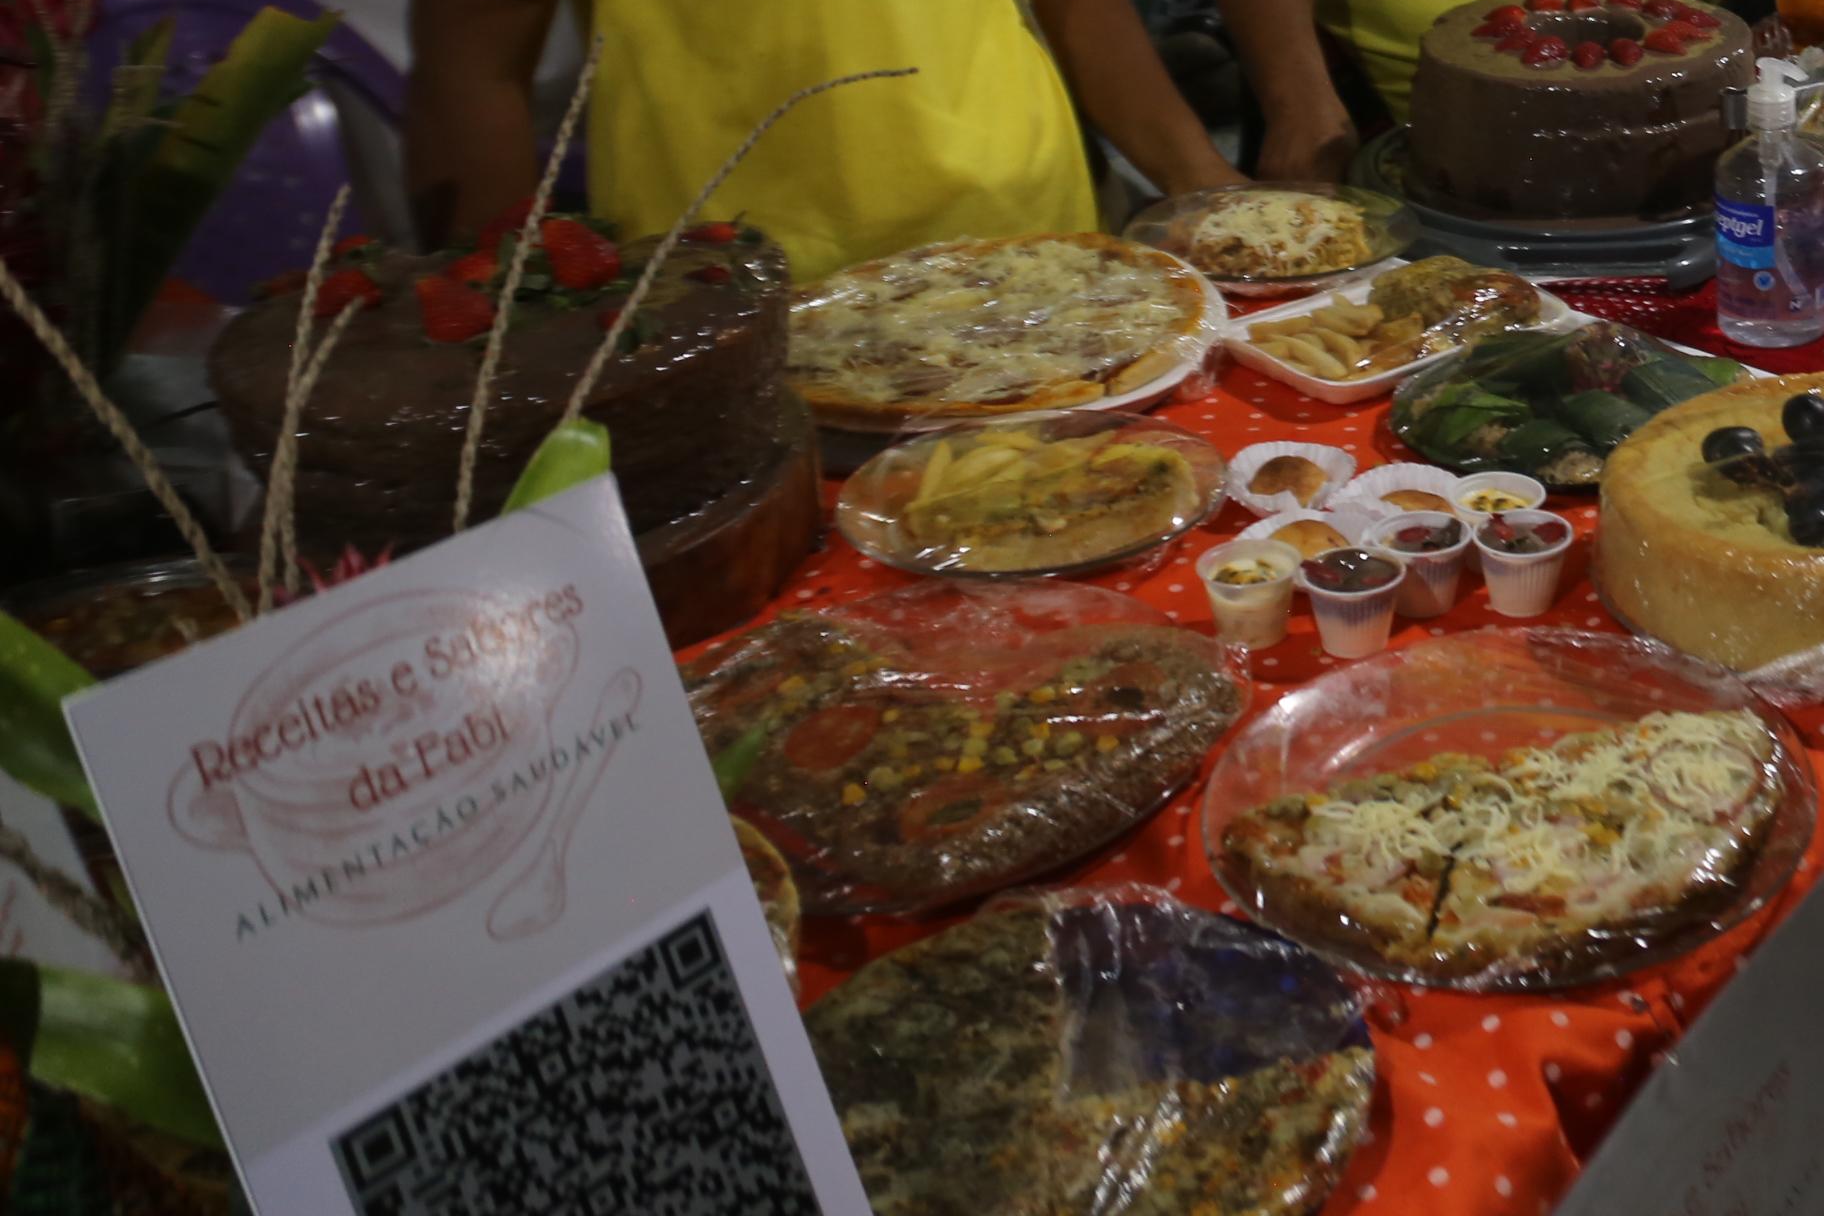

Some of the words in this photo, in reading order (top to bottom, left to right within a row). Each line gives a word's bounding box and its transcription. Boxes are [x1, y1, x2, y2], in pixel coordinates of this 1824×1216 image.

[190, 679, 381, 790] Receitas
[391, 660, 418, 699] e
[424, 583, 585, 680] Sabores
[349, 762, 409, 812] da
[414, 703, 512, 780] Fabi
[236, 794, 479, 940] ALIMENTAÇÃO
